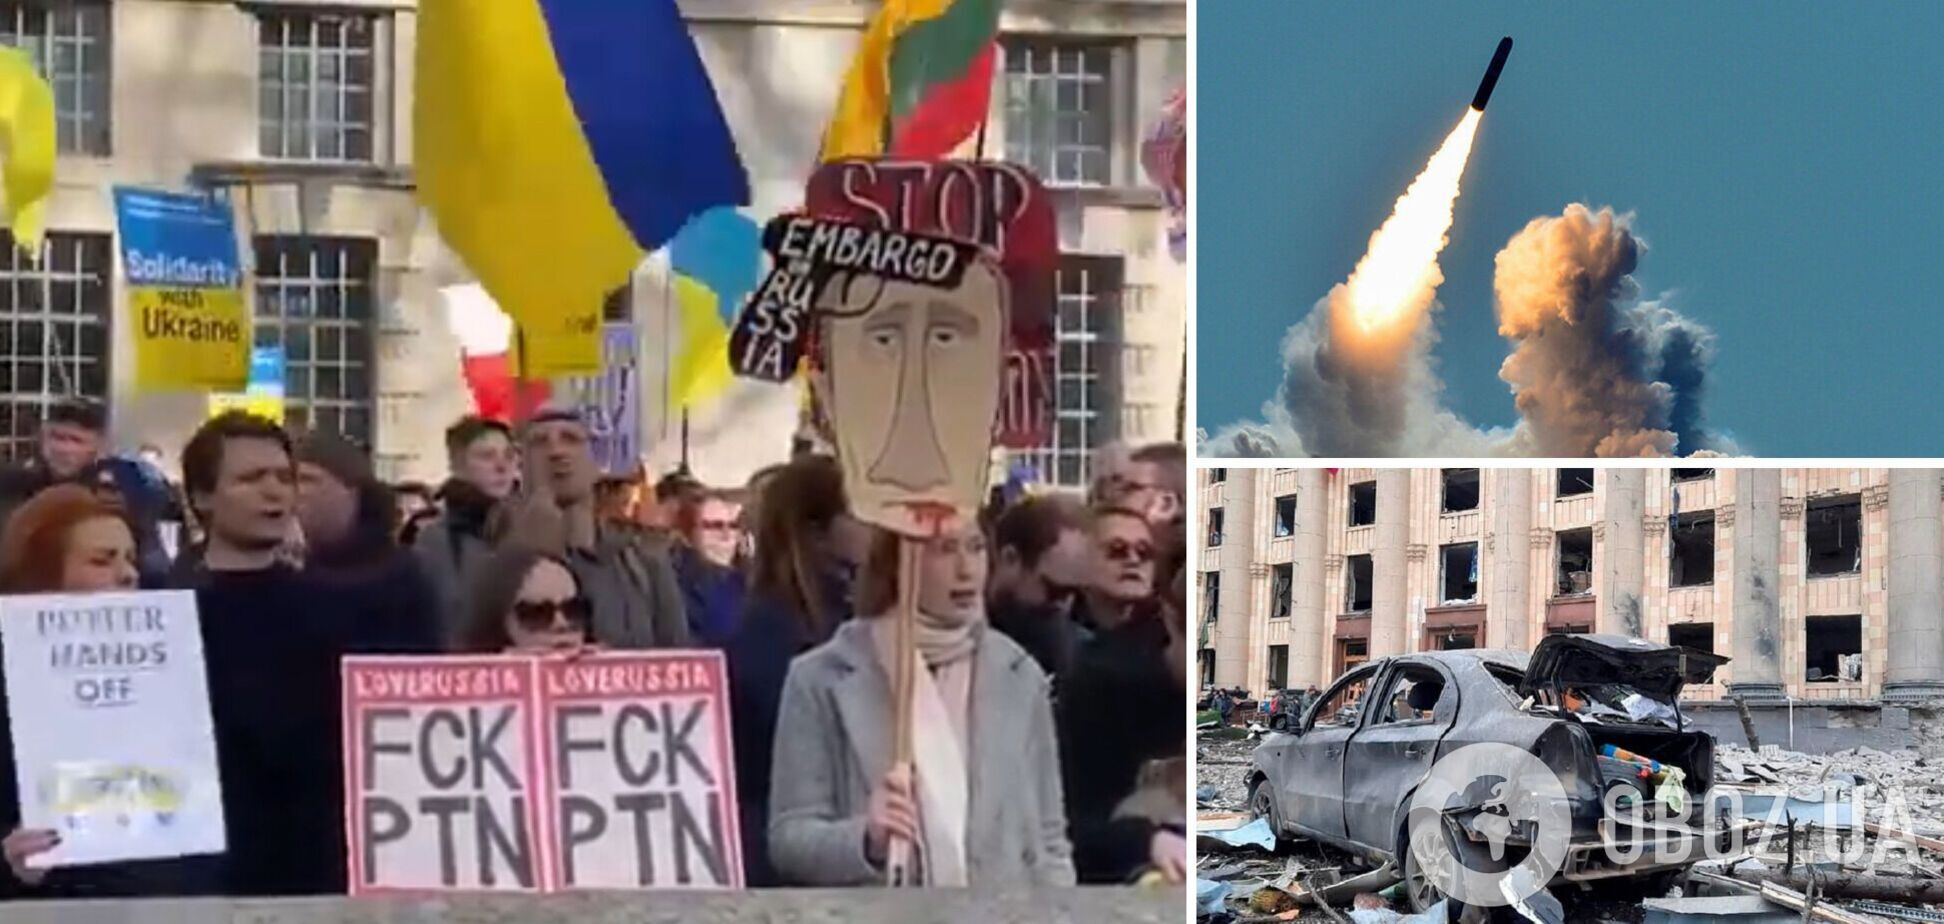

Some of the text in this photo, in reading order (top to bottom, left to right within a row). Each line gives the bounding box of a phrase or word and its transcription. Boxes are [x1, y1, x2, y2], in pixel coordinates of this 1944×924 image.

[843, 160, 1031, 259] STOP
[126, 249, 239, 289] Solidarity
[779, 218, 956, 281] EMBARGO
[143, 305, 239, 342] Ukraine
[157, 286, 204, 309] with
[50, 641, 168, 668] HANDS
[73, 676, 131, 702] OFF
[362, 704, 524, 791] FCK
[554, 699, 716, 789] FCK
[362, 795, 538, 888] PTN
[560, 791, 732, 887] PTN
